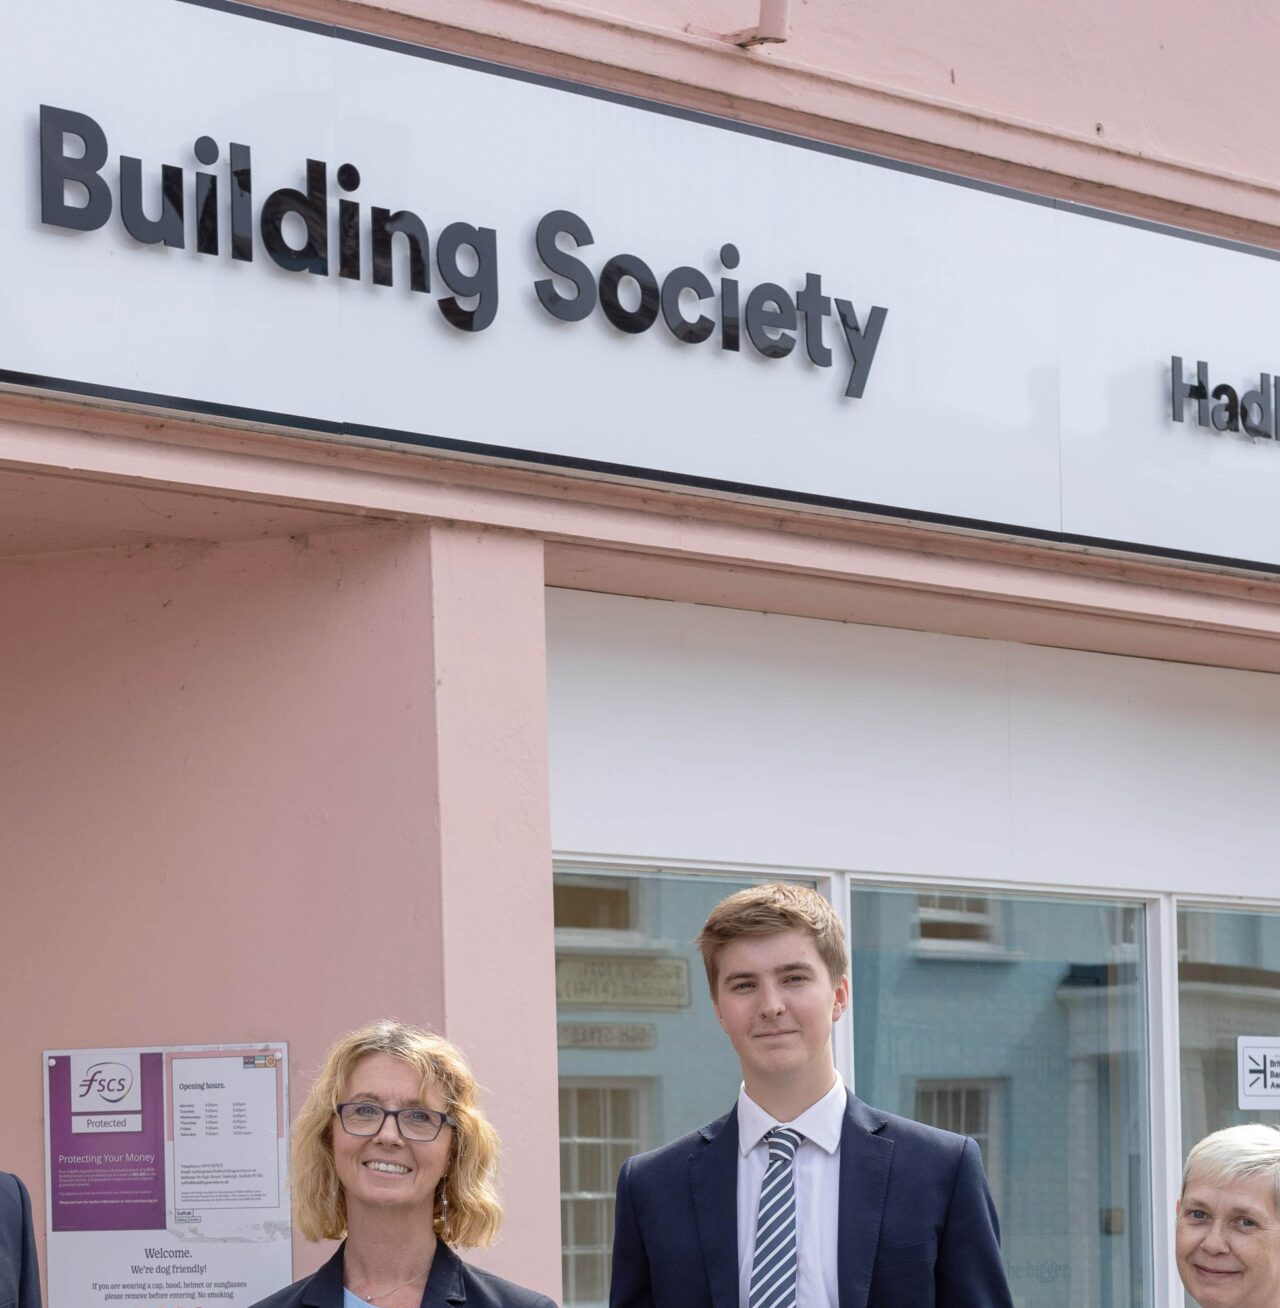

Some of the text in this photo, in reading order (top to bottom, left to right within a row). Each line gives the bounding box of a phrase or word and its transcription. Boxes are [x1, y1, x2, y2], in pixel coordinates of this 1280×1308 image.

[39, 104, 498, 333] Building
[533, 209, 888, 399] Society
[179, 1082, 205, 1091] Opening
[86, 1118, 127, 1128] Protected
[58, 1152, 155, 1165] Protecting Your Money
[144, 1248, 193, 1259] Welcome.
[131, 1264, 207, 1275] We're dog friendly!
[121, 1282, 147, 1291] wearing
[104, 1293, 124, 1301] please
[148, 1292, 169, 1300] before
[197, 1291, 206, 1299] No
